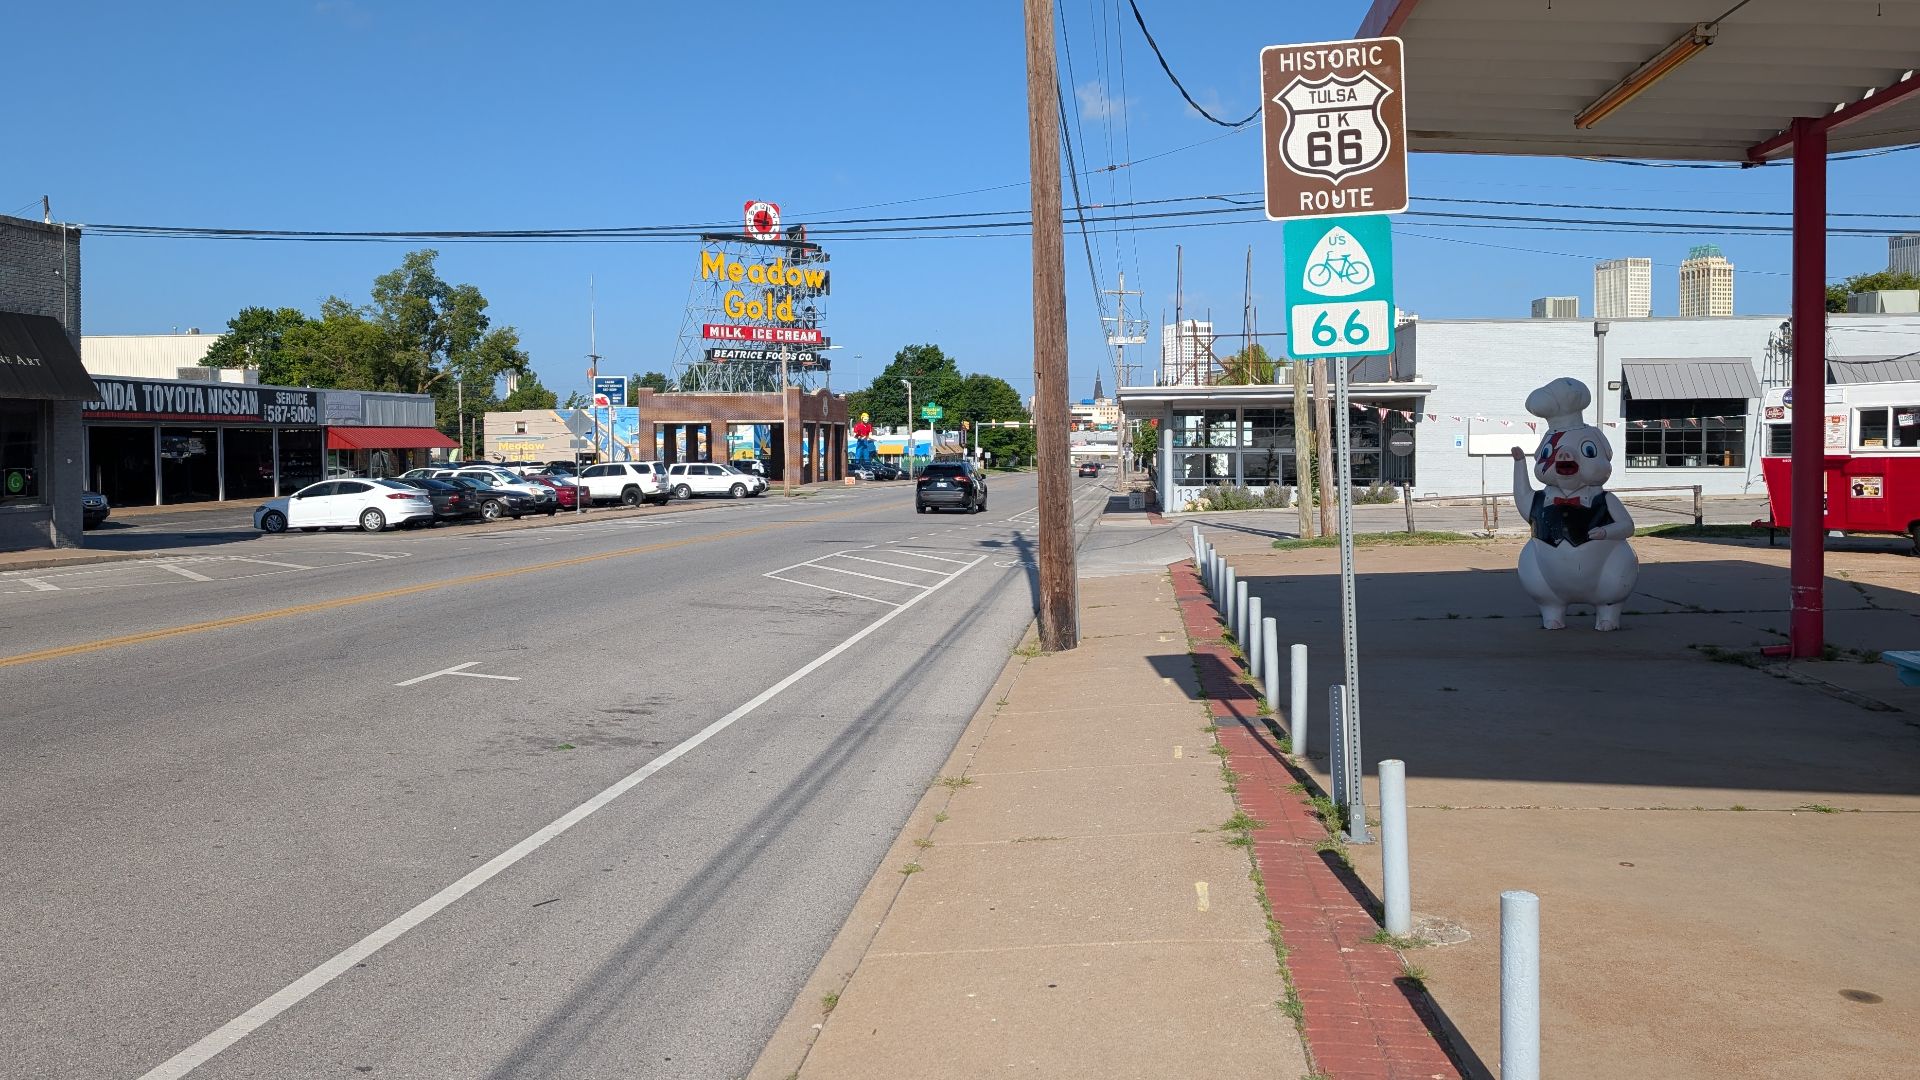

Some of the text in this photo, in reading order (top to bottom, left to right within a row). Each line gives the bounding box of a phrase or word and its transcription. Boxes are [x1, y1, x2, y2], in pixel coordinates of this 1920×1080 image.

[1280, 46, 1383, 72] HISTORIC
[1309, 88, 1358, 104] TULSA
[1307, 129, 1363, 167] 66
[1300, 187, 1374, 211] ROUTE
[1329, 235, 1347, 246] US
[701, 250, 825, 288] Meadow
[723, 290, 795, 322] Gold
[752, 328, 772, 339] ICE
[776, 329, 817, 341] CREAM
[1312, 308, 1370, 347] 66
[713, 349, 814, 361] BEATRICE FOODS CO.
[142, 384, 202, 414] TOYOTA
[207, 388, 259, 415] NISSAN
[275, 392, 308, 405] SERVICE
[267, 405, 317, 423] 587-5009
[498, 442, 545, 450] Meadow
